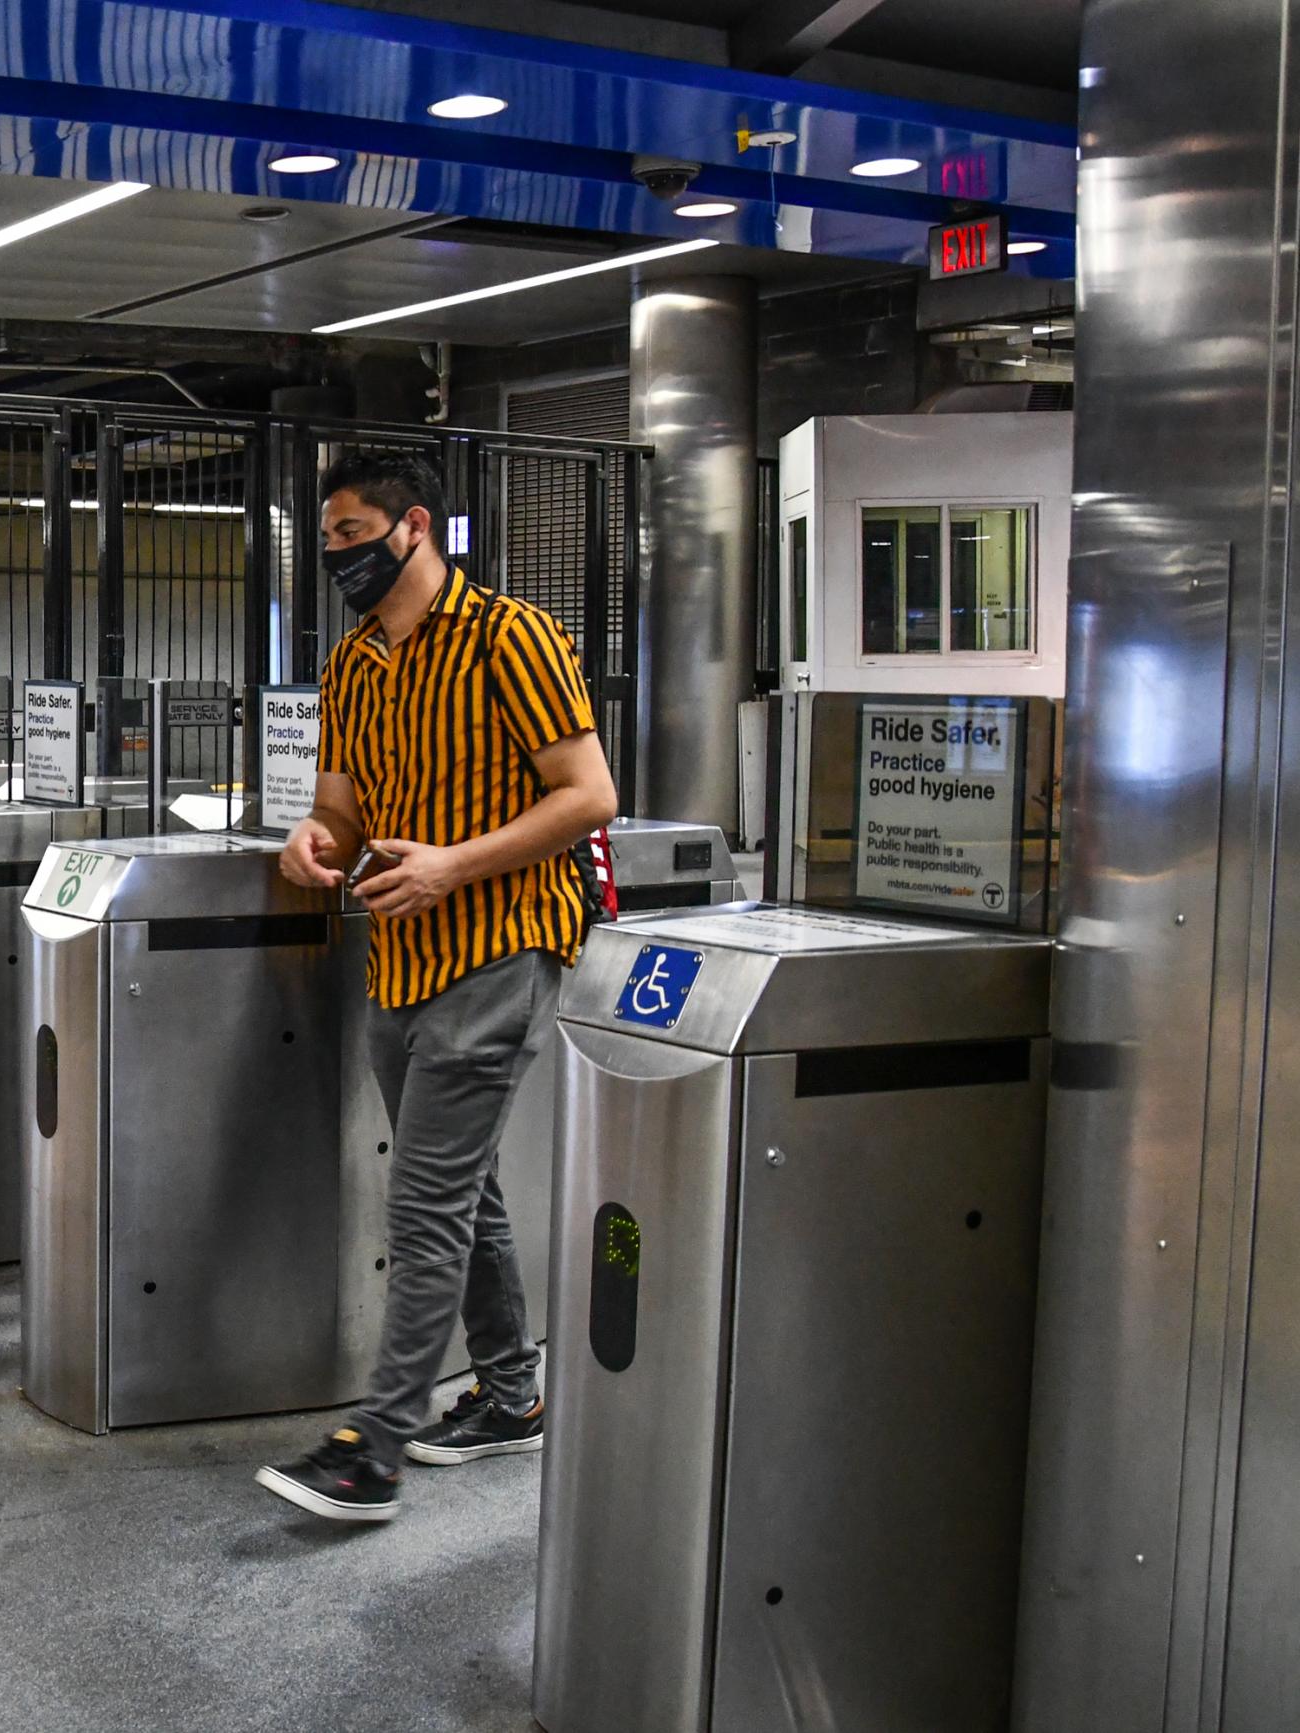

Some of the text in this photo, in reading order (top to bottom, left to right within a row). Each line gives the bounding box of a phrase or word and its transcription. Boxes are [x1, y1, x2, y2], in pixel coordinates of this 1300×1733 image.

[941, 223, 989, 273] EXIT
[27, 693, 72, 709] Ride Safer.
[170, 704, 219, 713] SERVICE
[27, 712, 54, 725] Practice
[168, 712, 224, 721] ATE ONLY
[266, 701, 321, 720] Ride Safe
[27, 727, 71, 740] good hygiene
[267, 725, 304, 740] Practice
[870, 716, 1002, 746] Ride Safer.
[266, 742, 317, 760] good hygie
[869, 751, 946, 774] Practice
[275, 776, 288, 785] your
[289, 776, 303, 786] part.
[868, 776, 996, 801] good hygiene
[266, 785, 283, 794] Public
[285, 787, 302, 797] health
[304, 789, 309, 797] is
[867, 821, 942, 840] Do your part.
[866, 837, 964, 858] Public health is a
[63, 851, 104, 876] EXIT
[865, 853, 984, 879] public responsibility.
[886, 879, 976, 897] mbta.com/ridesafer
